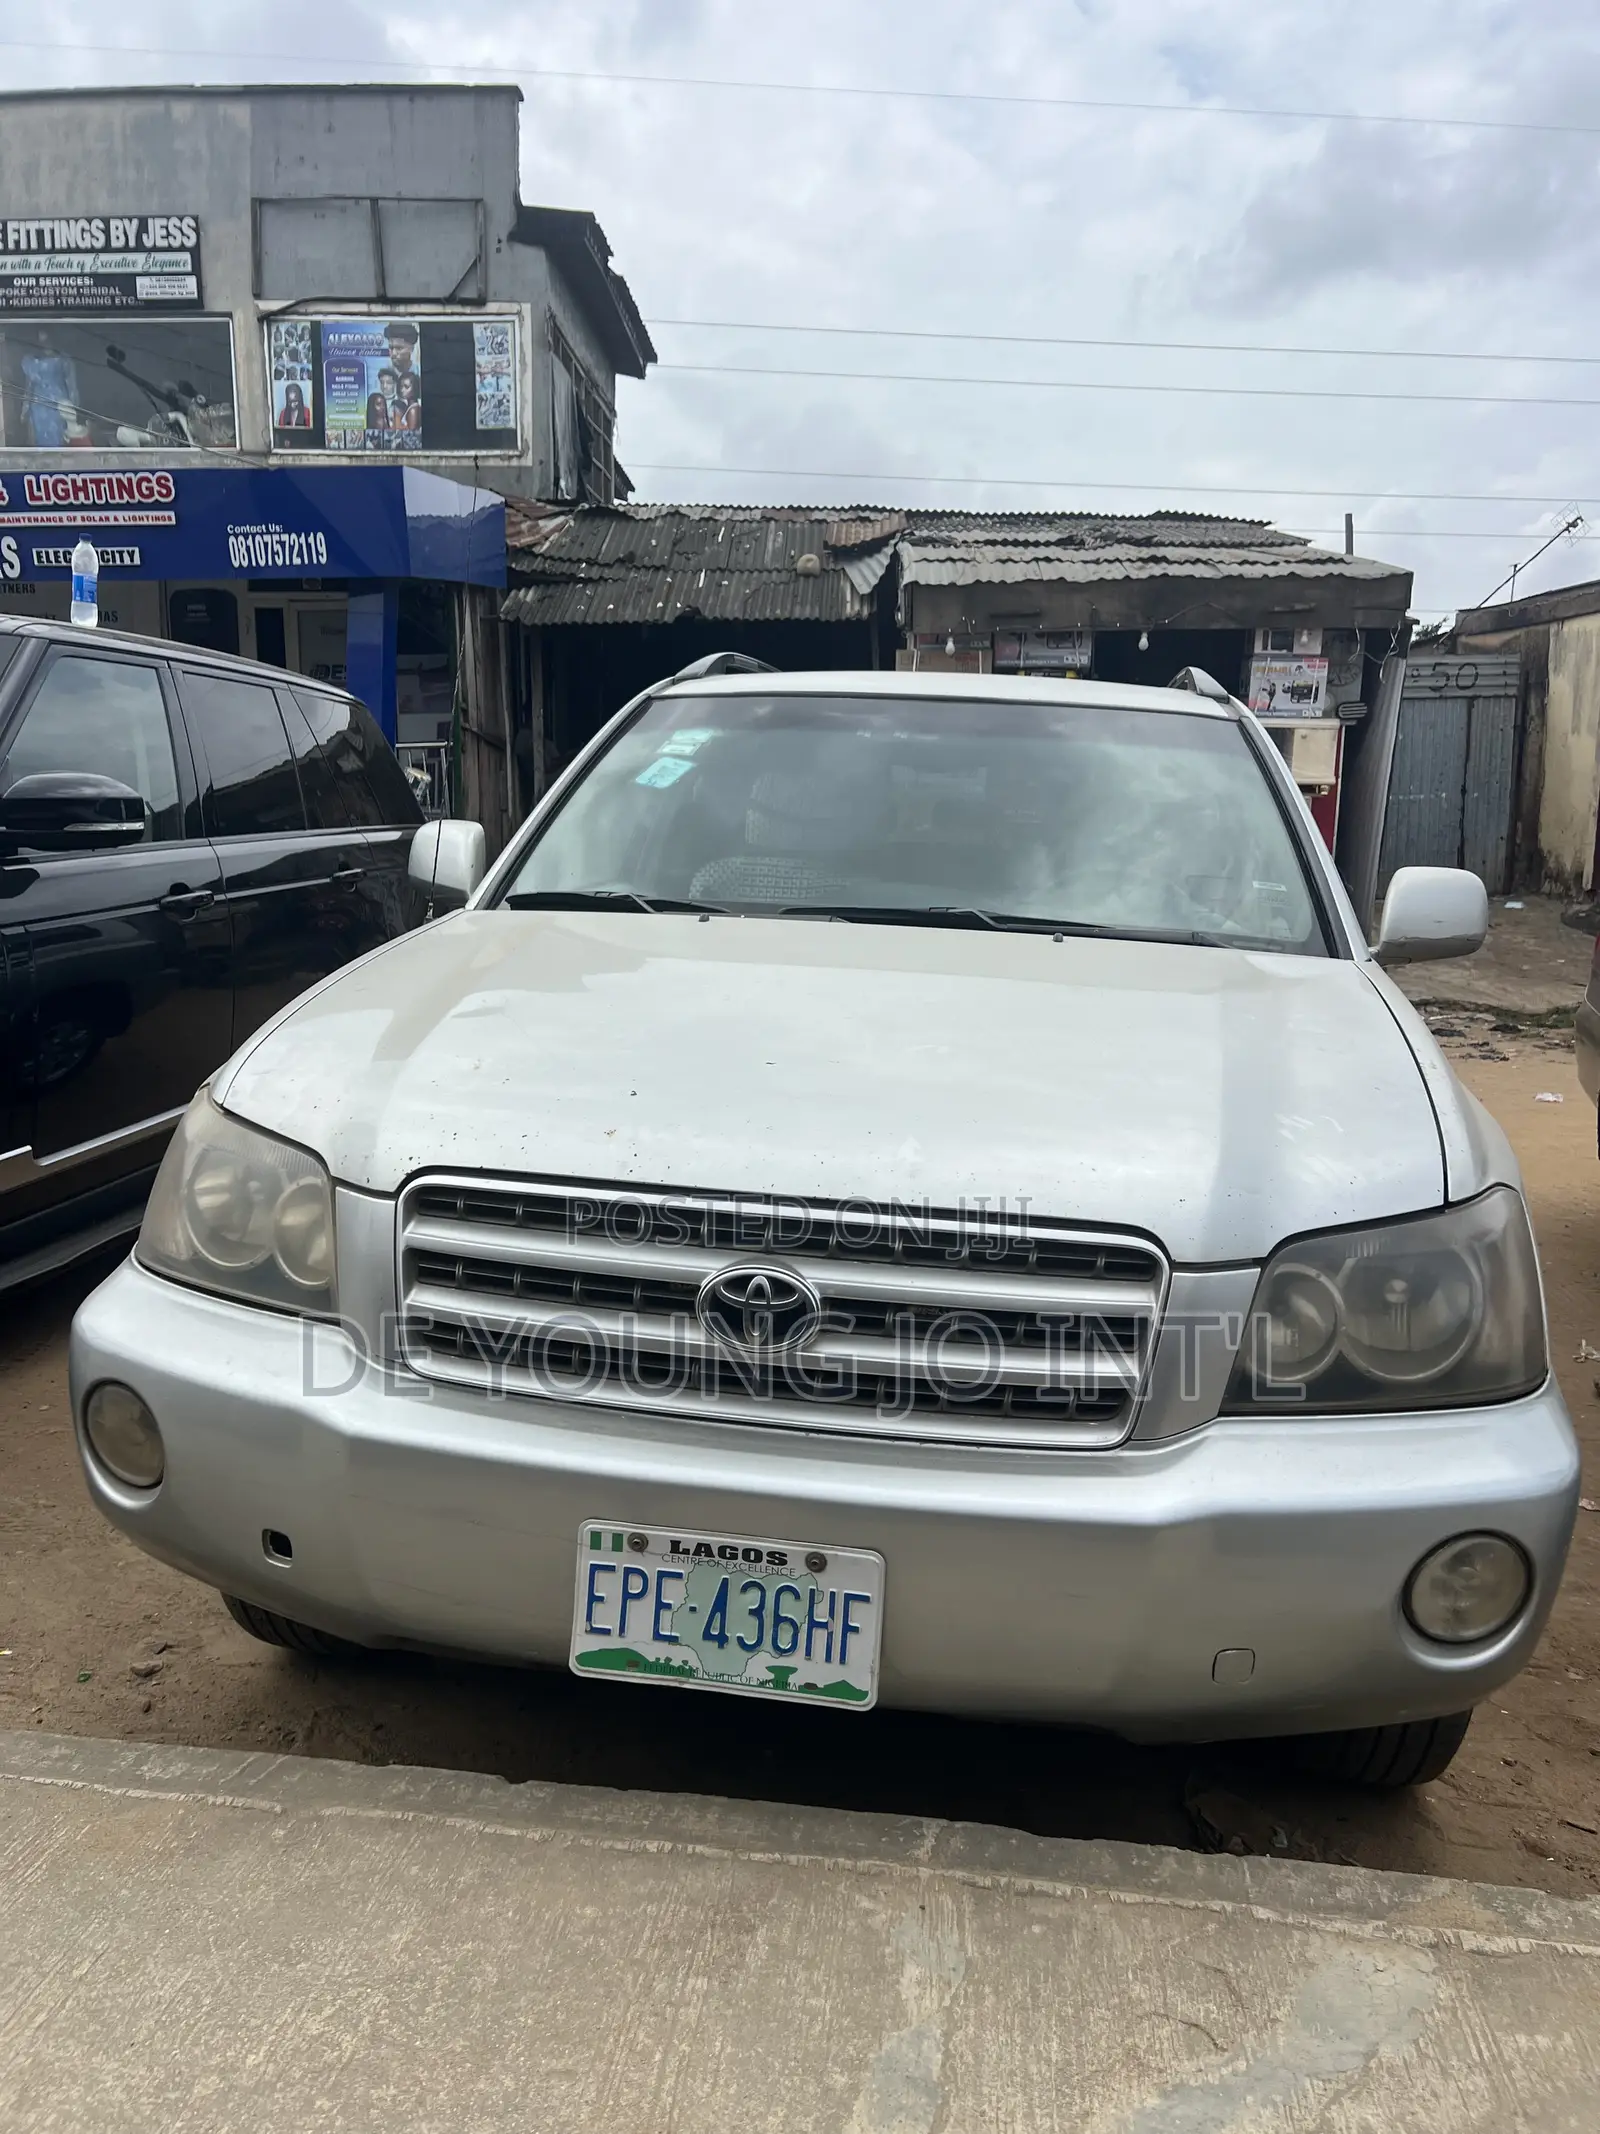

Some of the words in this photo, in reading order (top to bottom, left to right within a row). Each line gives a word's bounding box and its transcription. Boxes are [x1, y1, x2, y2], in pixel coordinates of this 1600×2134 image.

[7, 217, 105, 250] FITTINGS
[110, 217, 139, 249] BY
[142, 215, 197, 249] JESS
[10, 257, 31, 270] with
[90, 252, 137, 274] Executive
[142, 252, 188, 273] Elegance
[13, 277, 36, 286] OUR
[39, 276, 93, 286] SERVICES:
[62, 297, 111, 306] TRAINING
[25, 472, 174, 505] LIGHTINGS
[227, 523, 266, 534] Contact
[268, 522, 283, 533] Us:
[36, 549, 136, 564] ELECCITY
[228, 531, 327, 568] 08107572119
[1428, 662, 1478, 692] 50
[661, 1553, 705, 1567] CENTRE
[707, 1558, 720, 1568] OF
[725, 1560, 797, 1577] EXCELLENCE
[669, 1540, 788, 1567] LAGOS
[585, 1563, 871, 1665] EPE-436HF
[690, 1667, 737, 1683] REPUBLIC
[739, 1675, 753, 1685] OF
[756, 1677, 799, 1692] NIGERIA
